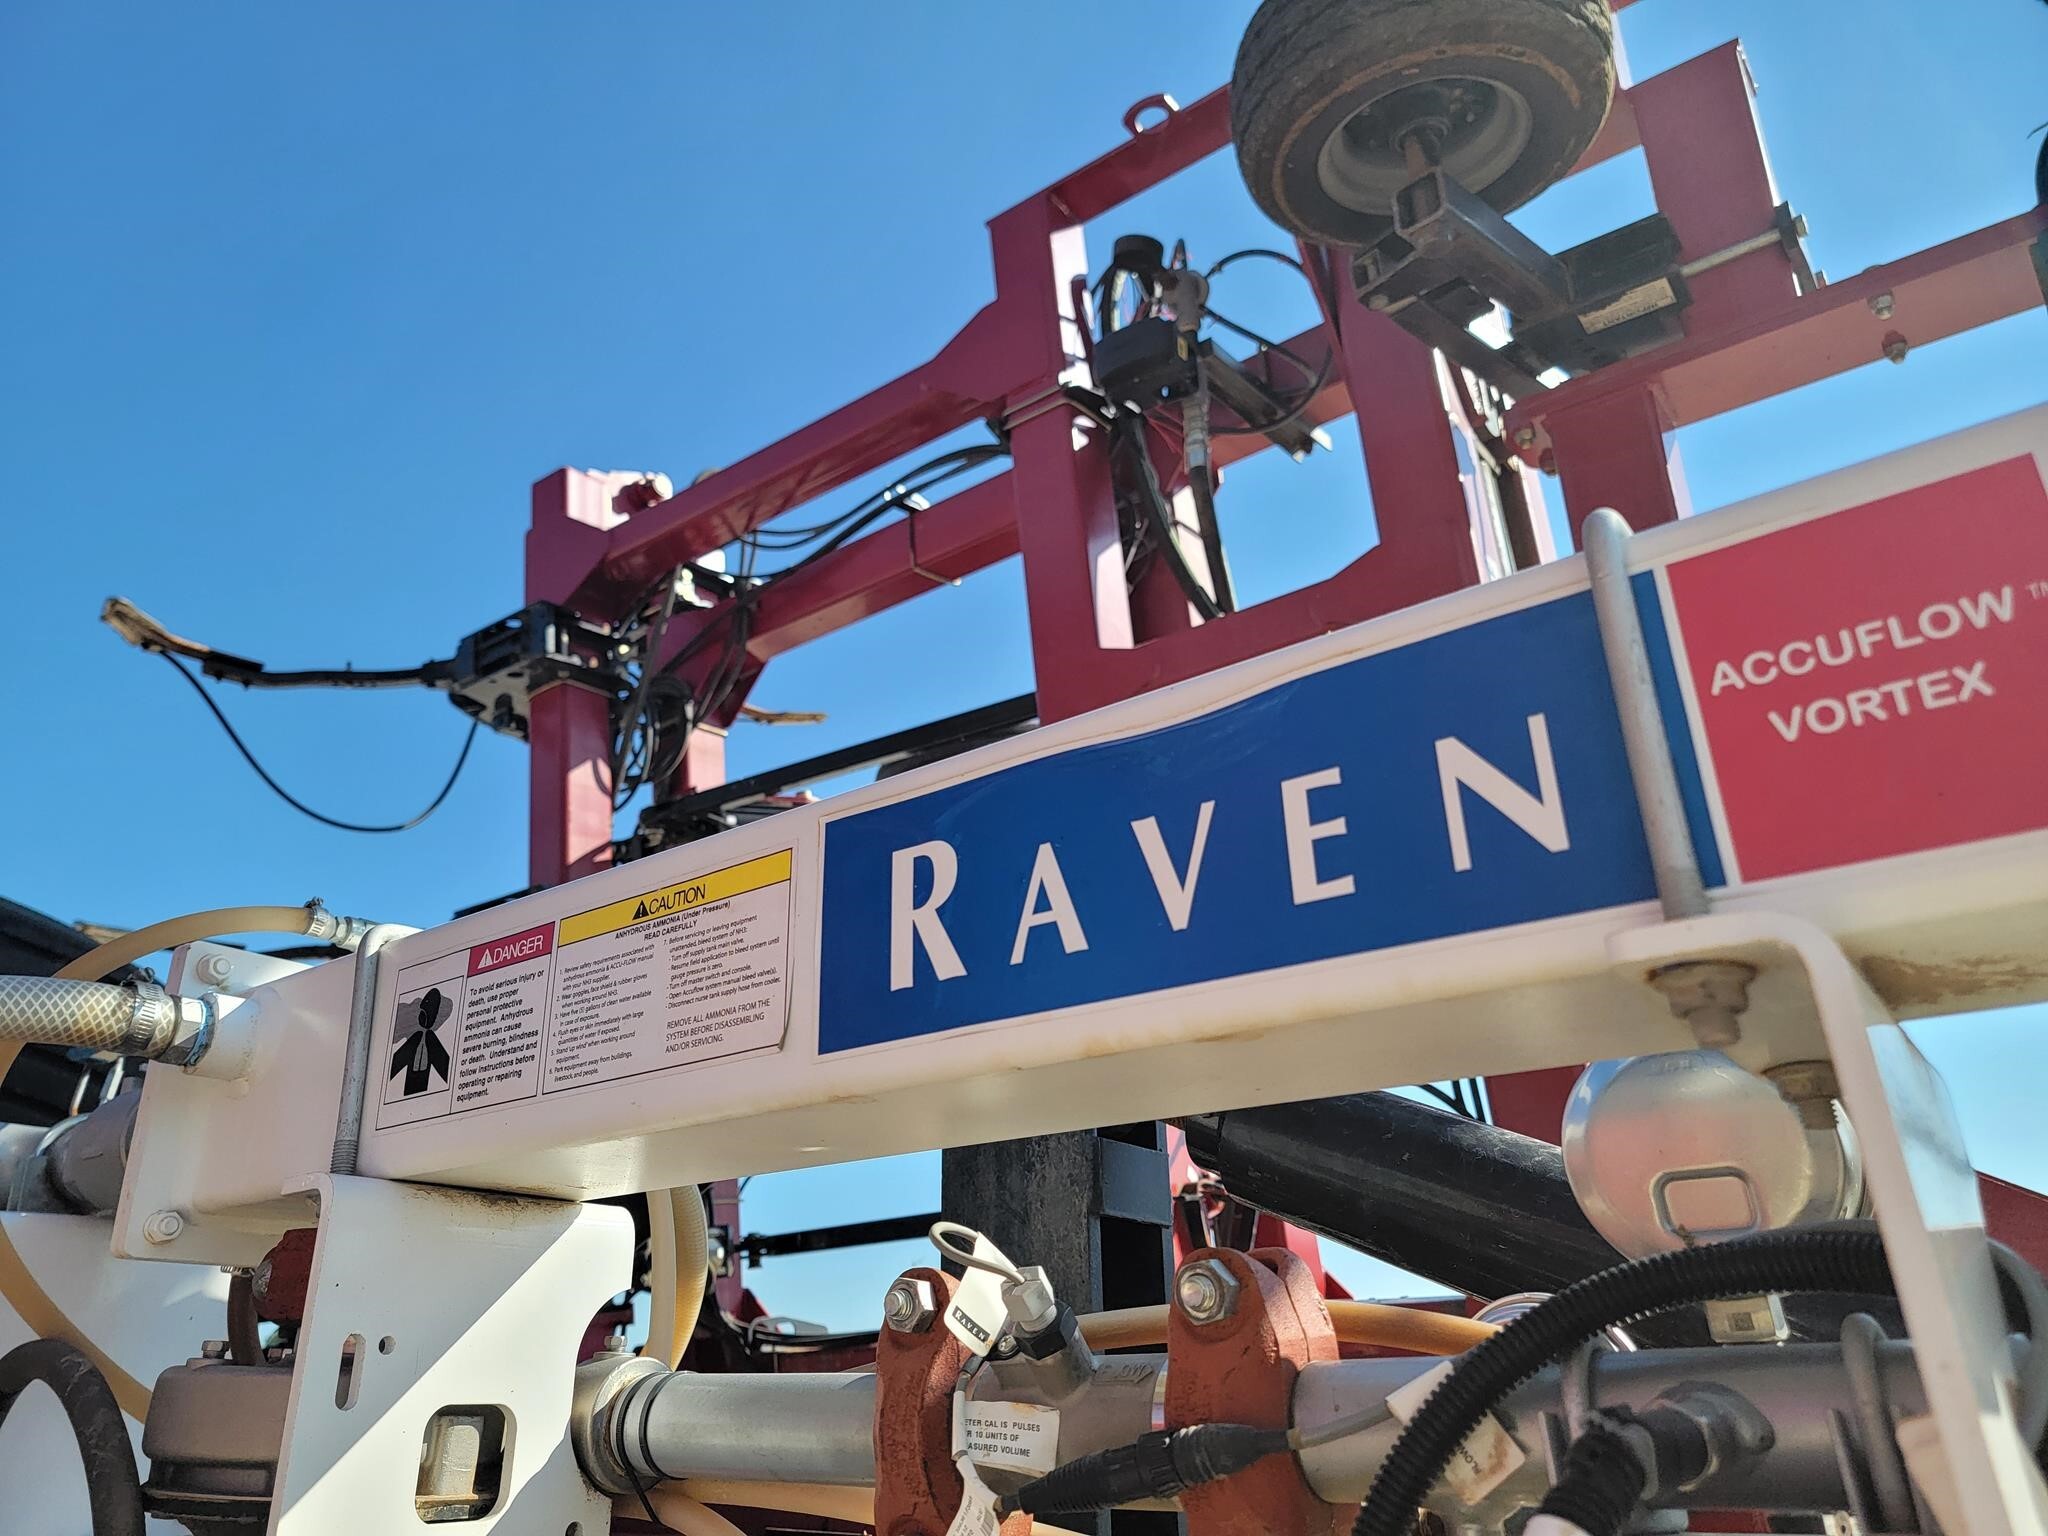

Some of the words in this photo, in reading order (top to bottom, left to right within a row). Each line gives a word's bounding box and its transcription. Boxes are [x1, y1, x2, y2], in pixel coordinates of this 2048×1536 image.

[1711, 585, 2014, 696] ACCUFLOW
[1768, 661, 1996, 743] VORTEX
[890, 713, 1571, 992] RAVEN
[648, 884, 705, 915] CAUTION
[615, 924, 650, 938] ANHYDROUS
[652, 915, 680, 927] AMMONIA
[681, 910, 700, 921] (Under
[703, 900, 730, 913] Pressure)
[644, 930, 660, 939] READ
[661, 919, 697, 935] CAREFULLY
[685, 930, 705, 939] servicing
[712, 923, 729, 931] leaving
[730, 915, 757, 926] equipment
[493, 935, 543, 963] DANGER
[698, 936, 711, 945] bleed
[712, 933, 728, 942] system
[690, 948, 704, 956] supply
[701, 952, 727, 963] application
[750, 941, 766, 950] system
[768, 937, 779, 945] until
[478, 983, 494, 993] avoid
[495, 978, 517, 988] serious
[519, 972, 536, 982] injury
[671, 972, 685, 981] gauge
[686, 967, 706, 976] pressure
[705, 972, 720, 980] switch
[705, 982, 721, 990] system
[723, 976, 740, 985] manual
[742, 972, 756, 980] bleed
[487, 994, 497, 1002] use
[499, 988, 518, 1000] proper
[668, 998, 694, 1008] Disconnect
[721, 987, 737, 996] supply
[465, 1017, 496, 1030] equipment.
[500, 1008, 533, 1021] Anhydrous
[466, 1006, 492, 1020] personal
[493, 999, 522, 1013] protective
[667, 1017, 691, 1028] REMOVE
[705, 1006, 736, 1020] AMMONIA
[738, 1001, 756, 1012] FROM
[758, 998, 769, 1007] THE
[464, 1030, 490, 1042] ammonia
[491, 1027, 502, 1035] can
[503, 1022, 521, 1031] cause
[666, 1029, 688, 1041] SYSTEM
[690, 1024, 712, 1035] BEFORE
[714, 1012, 764, 1030] DISASSEMBLING
[462, 1044, 481, 1053] severe
[509, 1030, 538, 1042] blindness
[489, 1043, 524, 1058] Understand
[525, 1040, 537, 1050] and
[665, 1041, 689, 1052] AND/OR
[459, 1068, 476, 1077] follow
[478, 1059, 513, 1072] instructions
[515, 1054, 534, 1064] before
[458, 1078, 485, 1090] operating
[495, 1070, 521, 1081] repairing
[955, 1310, 986, 1340] RAVEN
[985, 1420, 998, 1428] CAL
[1013, 1421, 1041, 1432] PULSES
[985, 1432, 1008, 1441] UNITS
[1010, 1434, 1020, 1442] OF
[967, 1442, 998, 1453] ASURED
[1001, 1446, 1031, 1457] VOLUME
